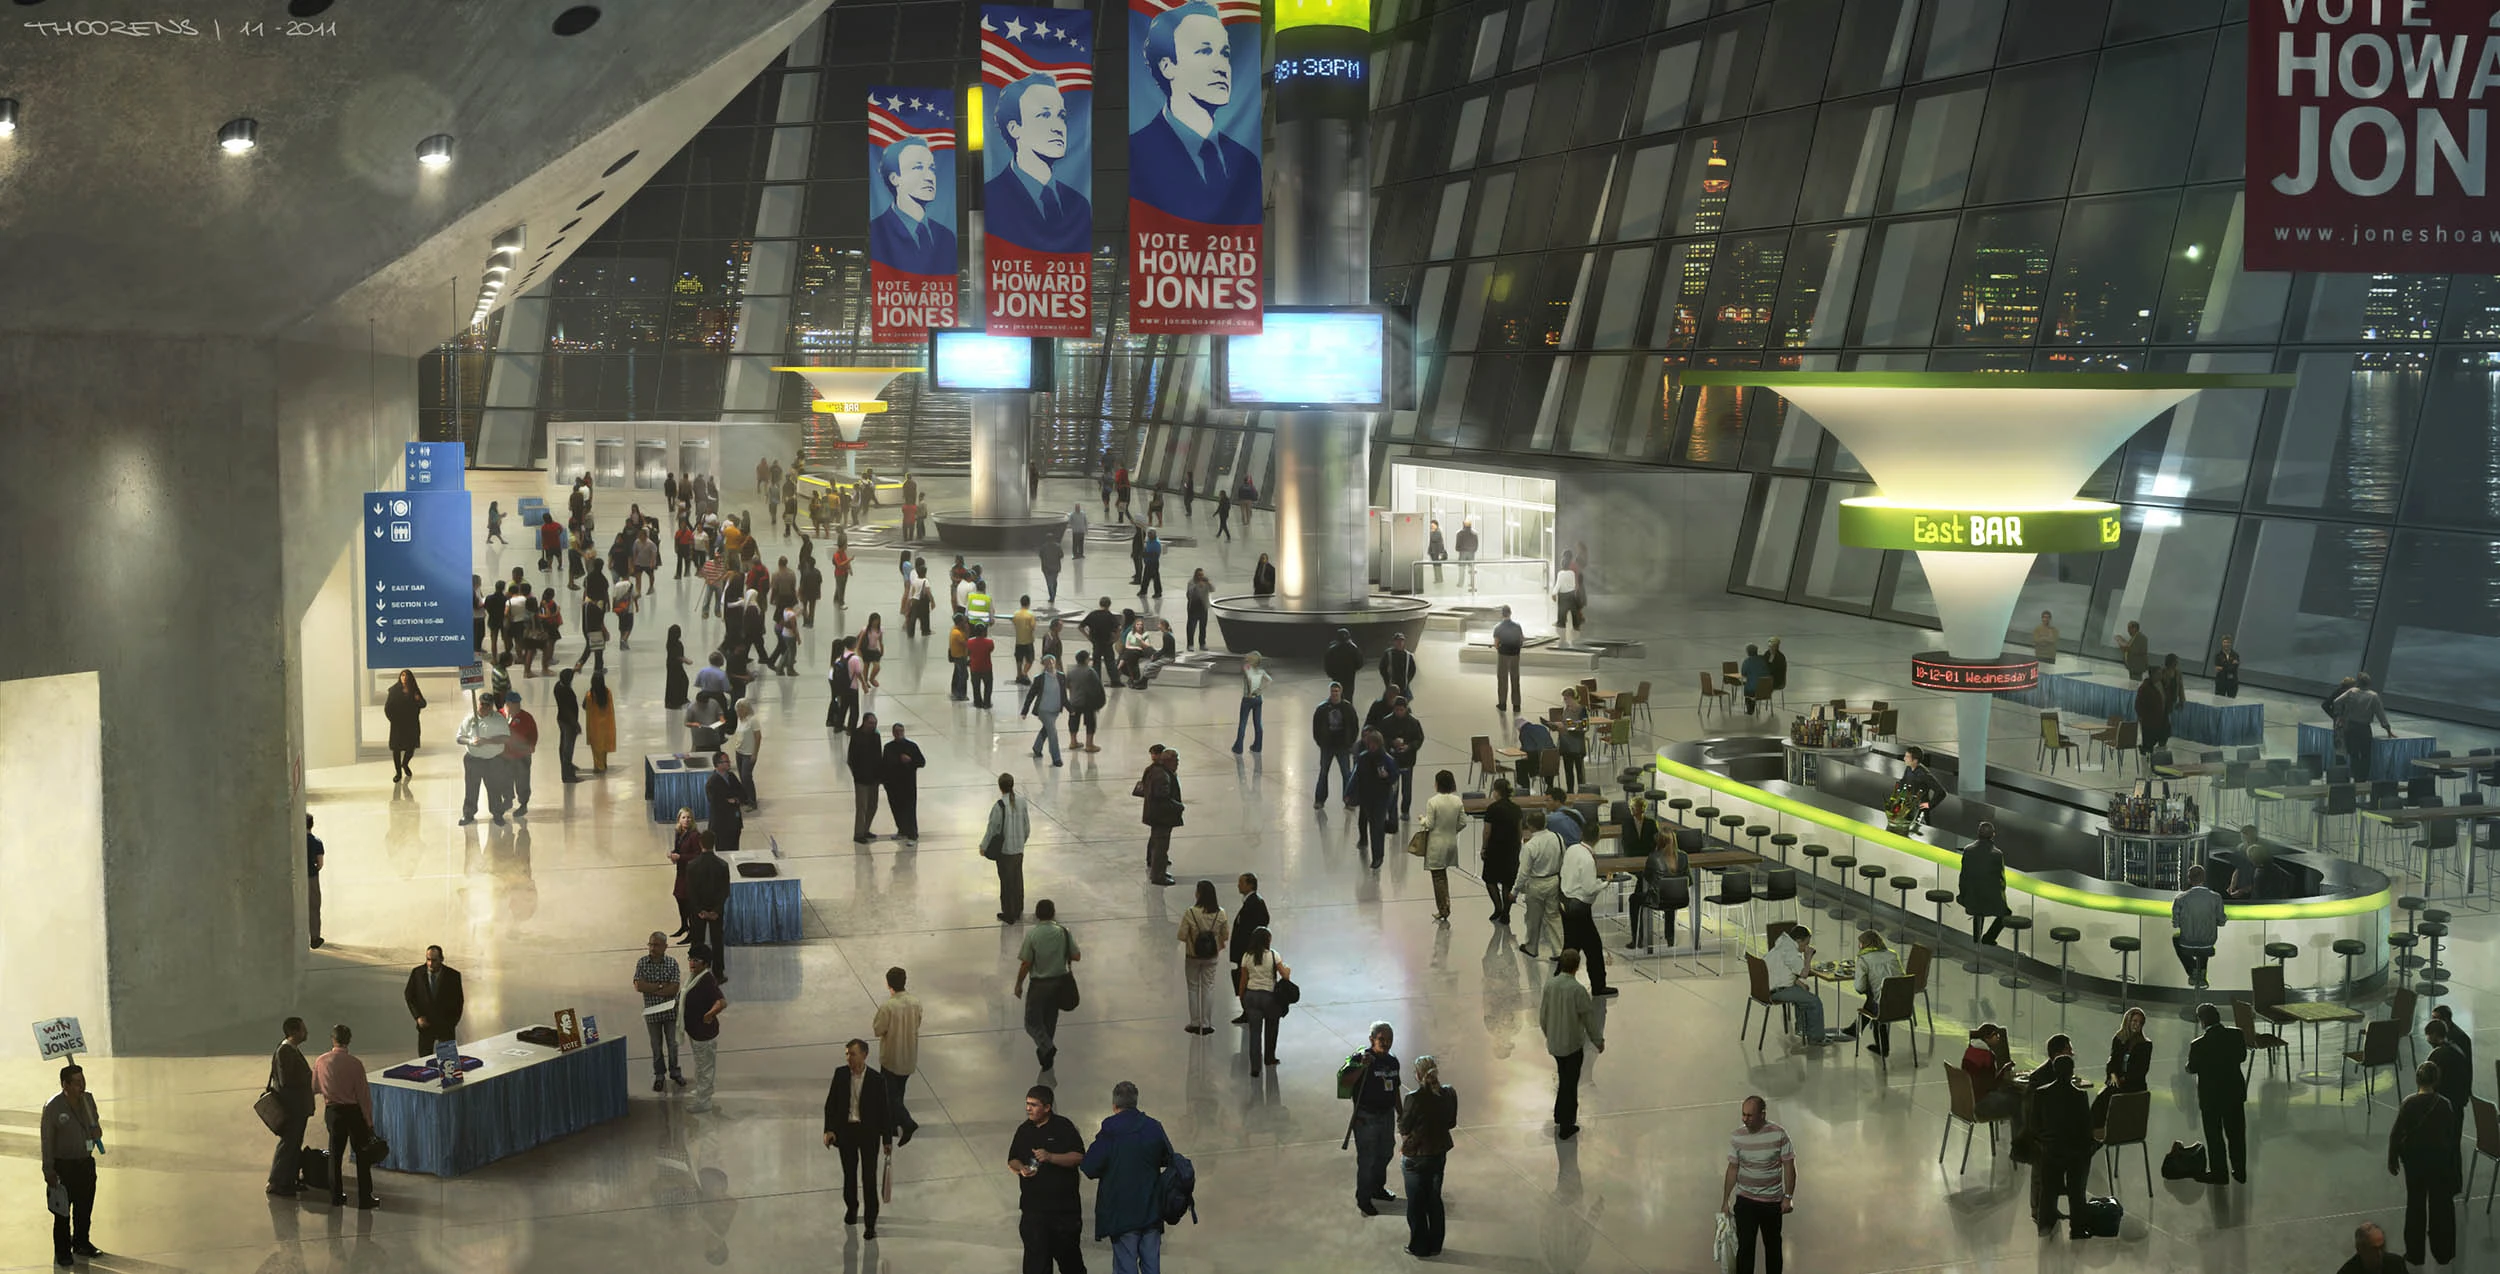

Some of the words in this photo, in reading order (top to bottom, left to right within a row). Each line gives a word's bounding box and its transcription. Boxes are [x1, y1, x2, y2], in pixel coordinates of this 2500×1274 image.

[2282, 0, 2432, 26] VOTE
[2271, 106, 2488, 196] JON
[1138, 233, 1190, 249] VOTE
[1207, 235, 1256, 251] 2011
[992, 259, 1033, 273] VOTE
[1047, 261, 1086, 274] 2011
[1139, 250, 1256, 276] HOWARD
[877, 281, 910, 291] VOTE
[921, 281, 953, 292] 2011
[992, 273, 1087, 293] HOWARD
[877, 291, 954, 307] HOWARD
[1138, 276, 1257, 310] JONES
[992, 292, 1087, 319] JONES
[877, 307, 955, 327] JONES
[1913, 514, 1964, 544] East
[1970, 515, 2023, 546] BAR
[1966, 671, 2027, 684] Wednesday
[44, 1037, 84, 1055] JONES
[50, 1032, 70, 1041] with
[562, 1041, 579, 1051] VOTE
